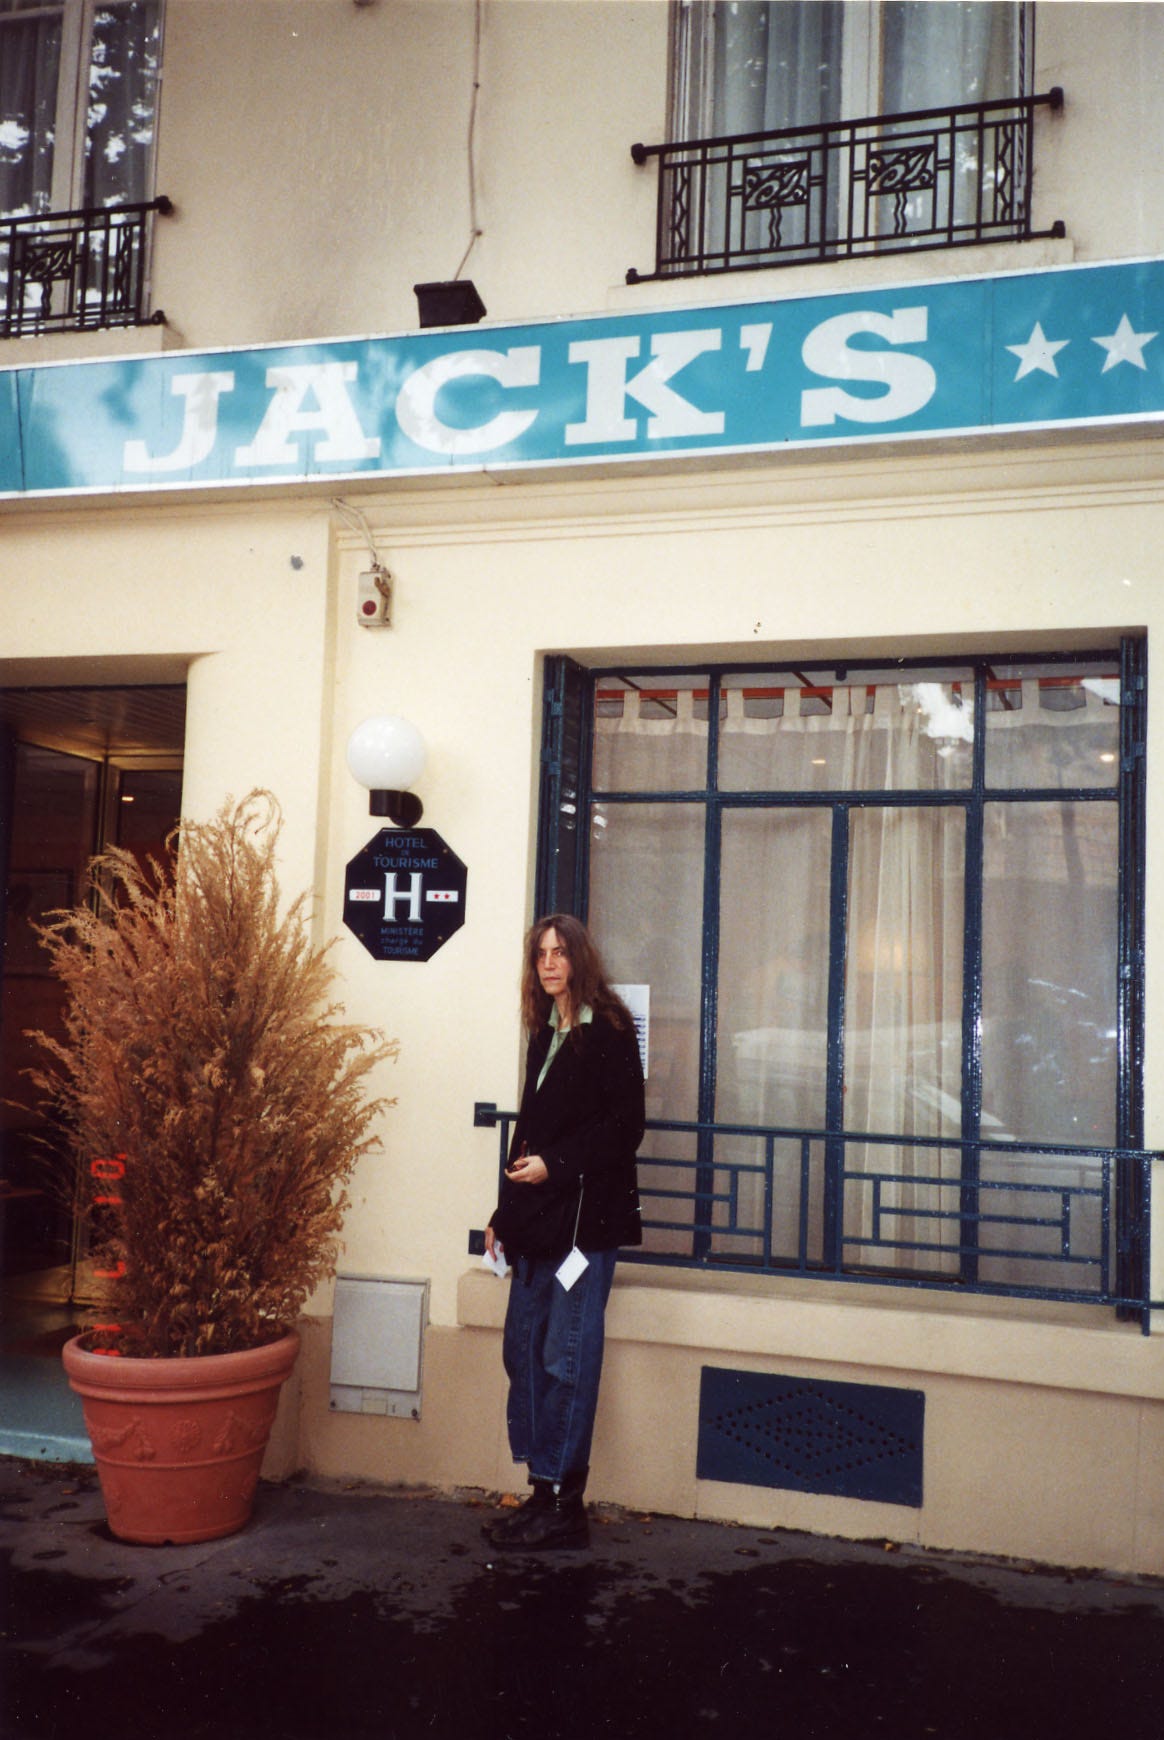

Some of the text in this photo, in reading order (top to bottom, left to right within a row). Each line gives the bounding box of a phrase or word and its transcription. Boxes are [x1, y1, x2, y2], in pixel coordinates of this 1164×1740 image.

[122, 305, 937, 473] JACK'S
[385, 837, 428, 849] HOTEL
[373, 856, 439, 869] TOURISME
[355, 891, 375, 899] 2001
[382, 872, 424, 922] H
